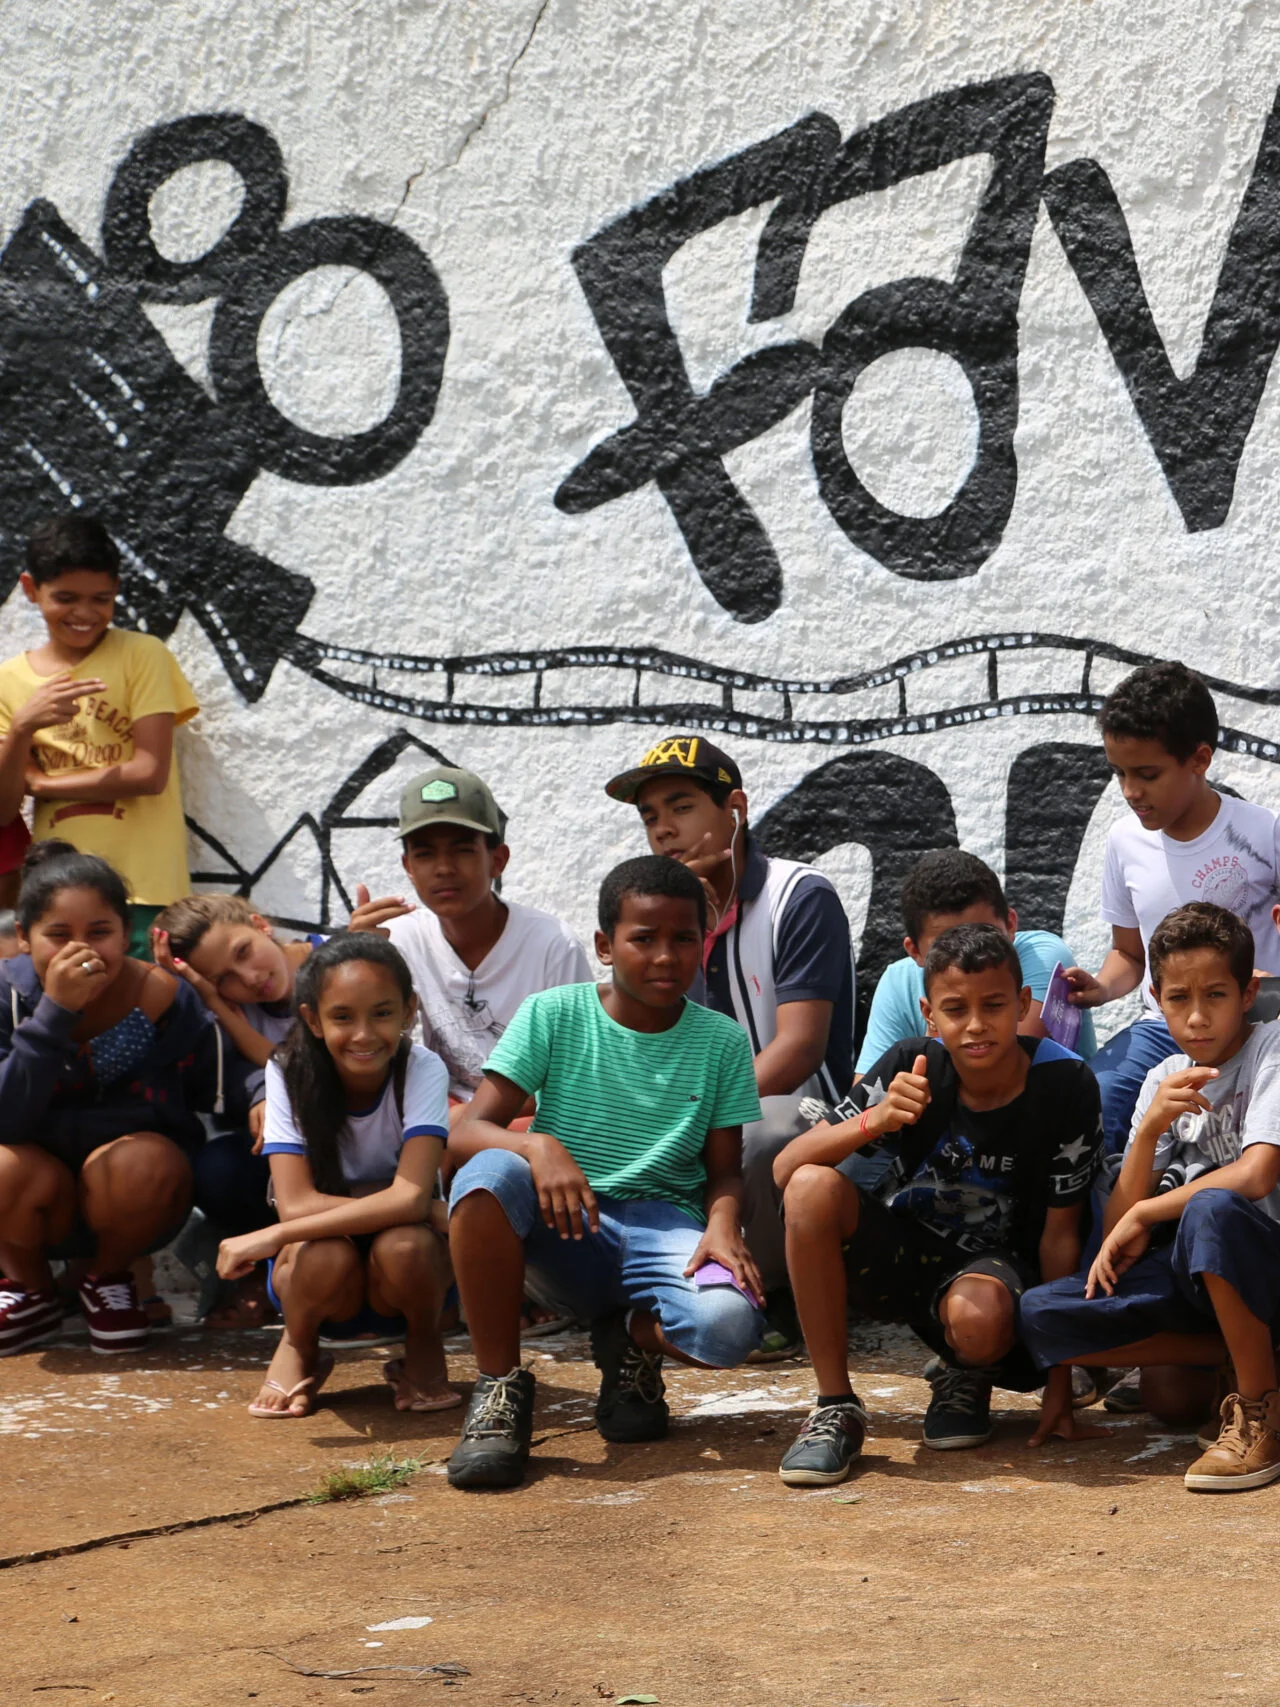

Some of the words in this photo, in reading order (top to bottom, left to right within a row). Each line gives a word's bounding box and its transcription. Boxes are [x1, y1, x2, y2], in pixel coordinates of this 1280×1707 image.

[86, 697, 134, 742] BEACH
[69, 741, 123, 768] Diego
[1191, 855, 1240, 889] CHAMPS
